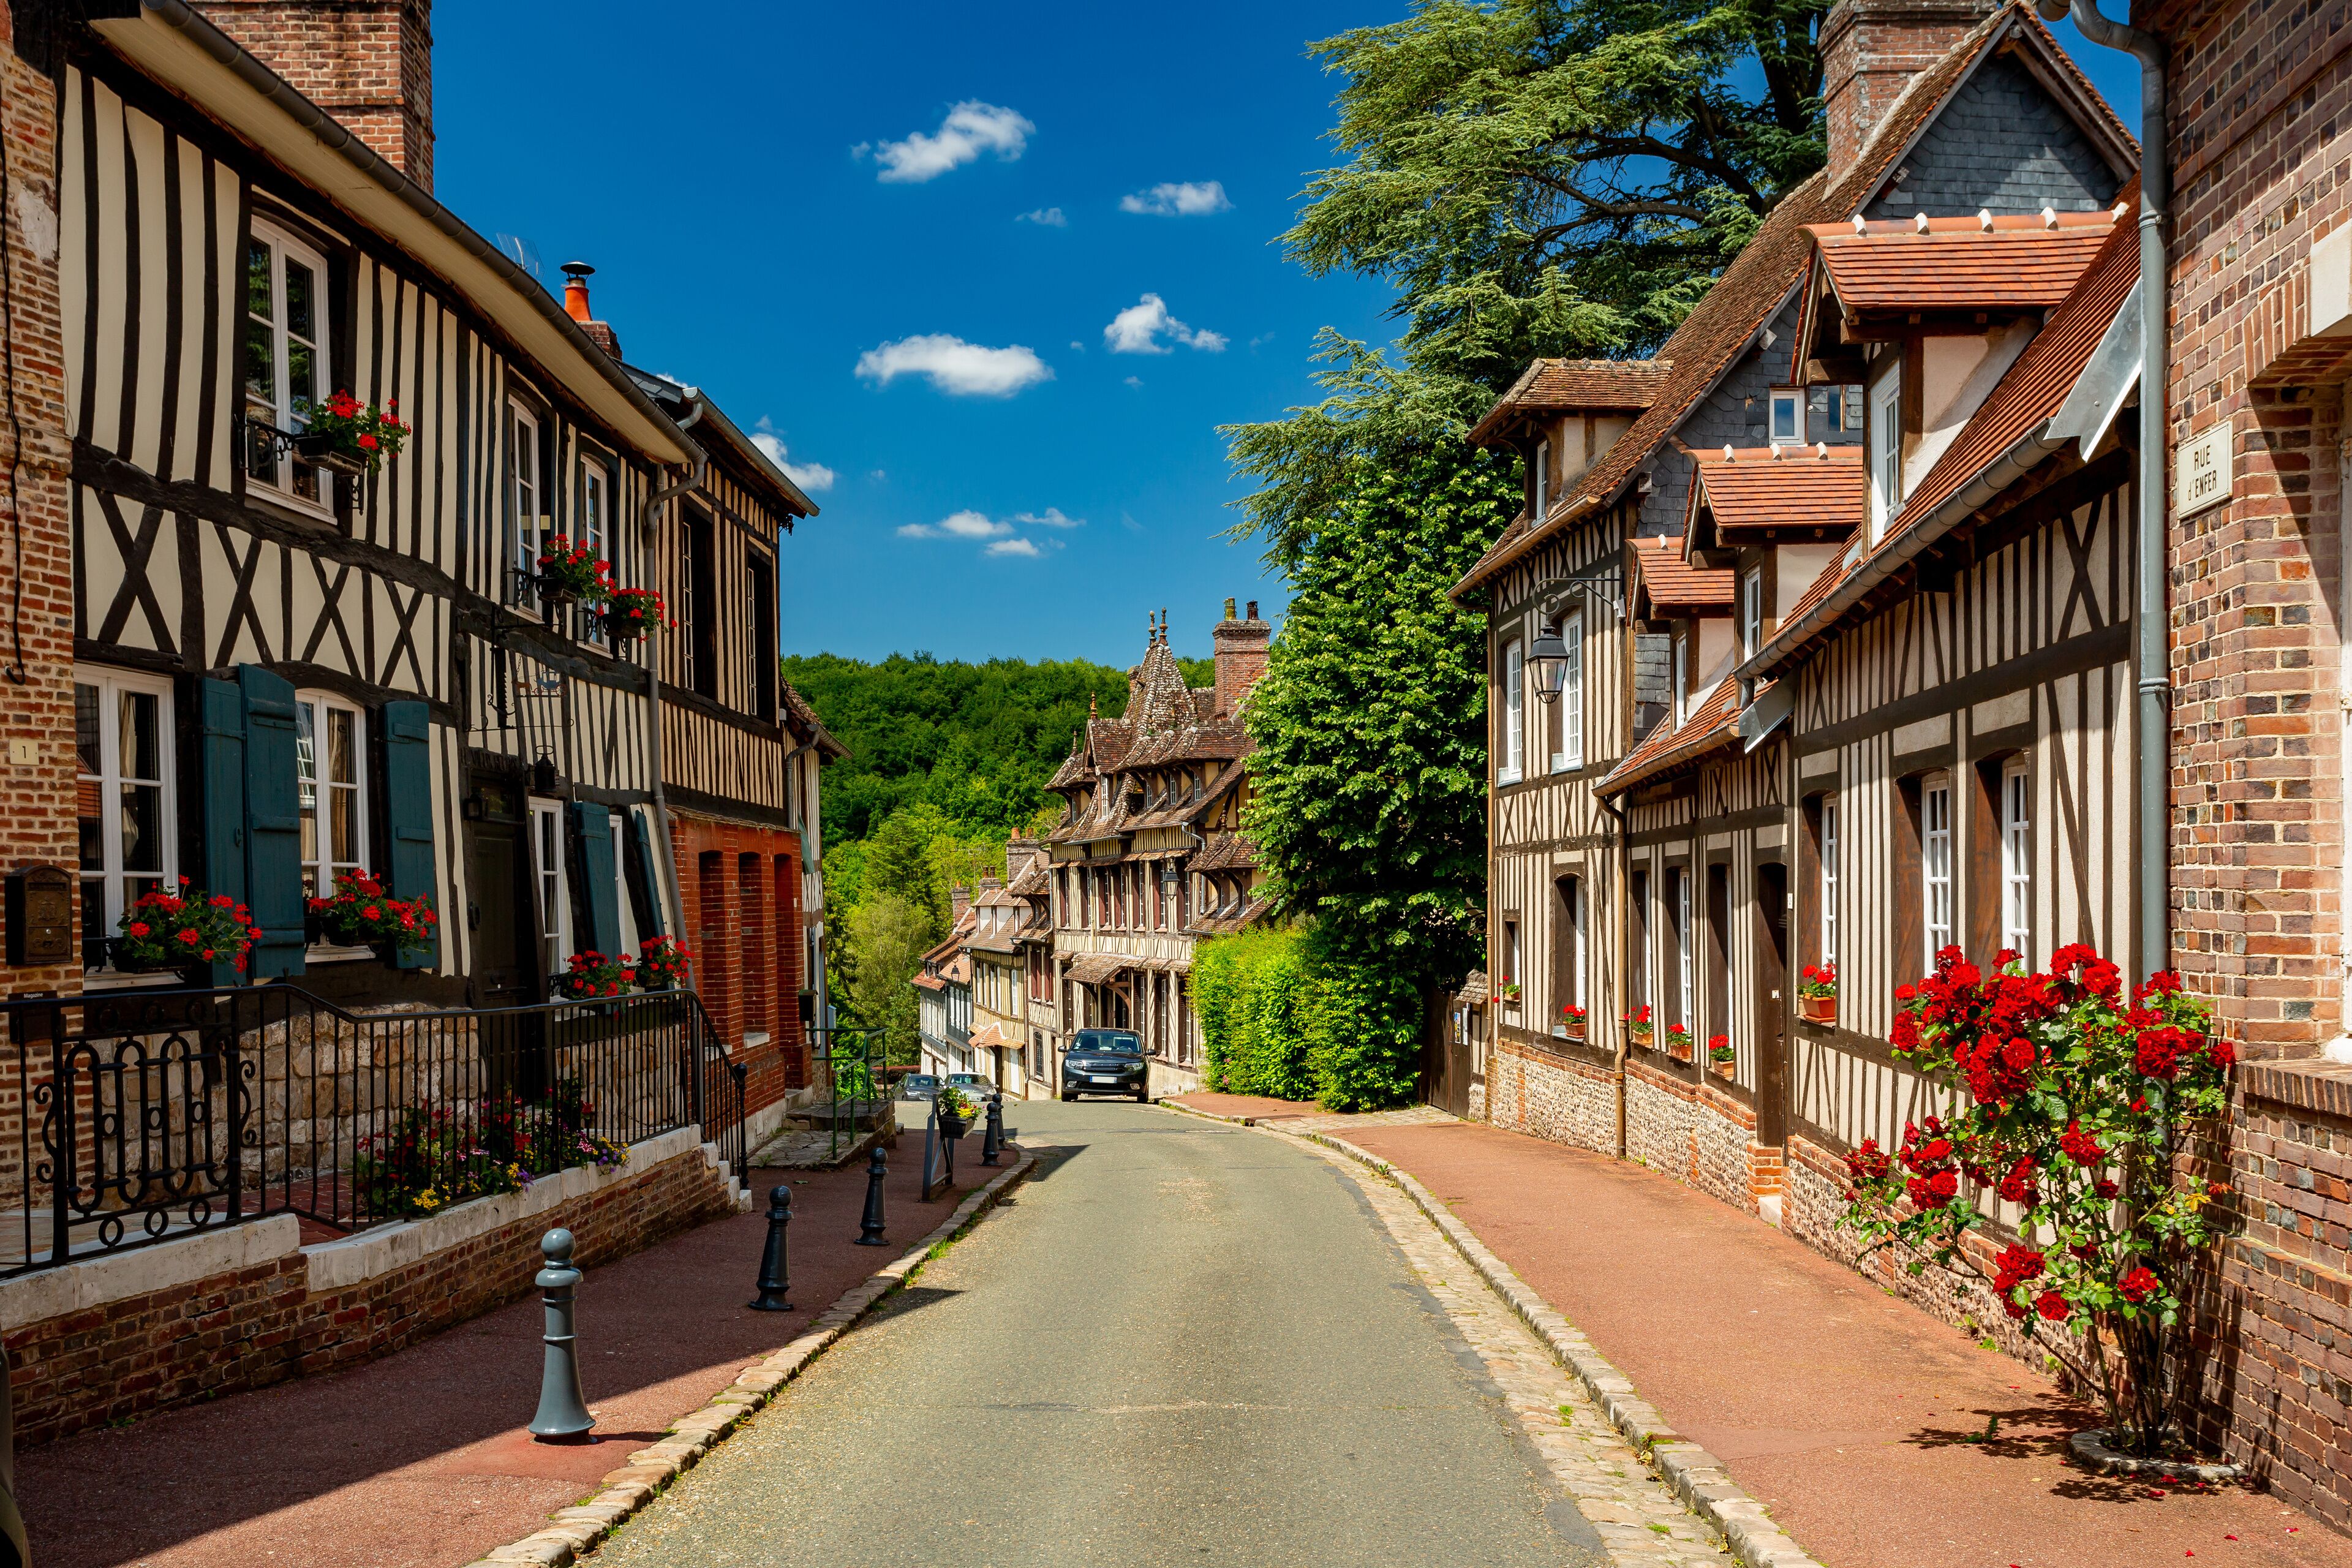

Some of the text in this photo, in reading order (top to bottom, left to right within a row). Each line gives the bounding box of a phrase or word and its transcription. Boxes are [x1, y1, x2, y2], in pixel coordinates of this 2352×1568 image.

[2194, 444, 2211, 471] RUE
[2188, 470, 2217, 501] d'ENFER
[22, 745, 26, 758] 1
